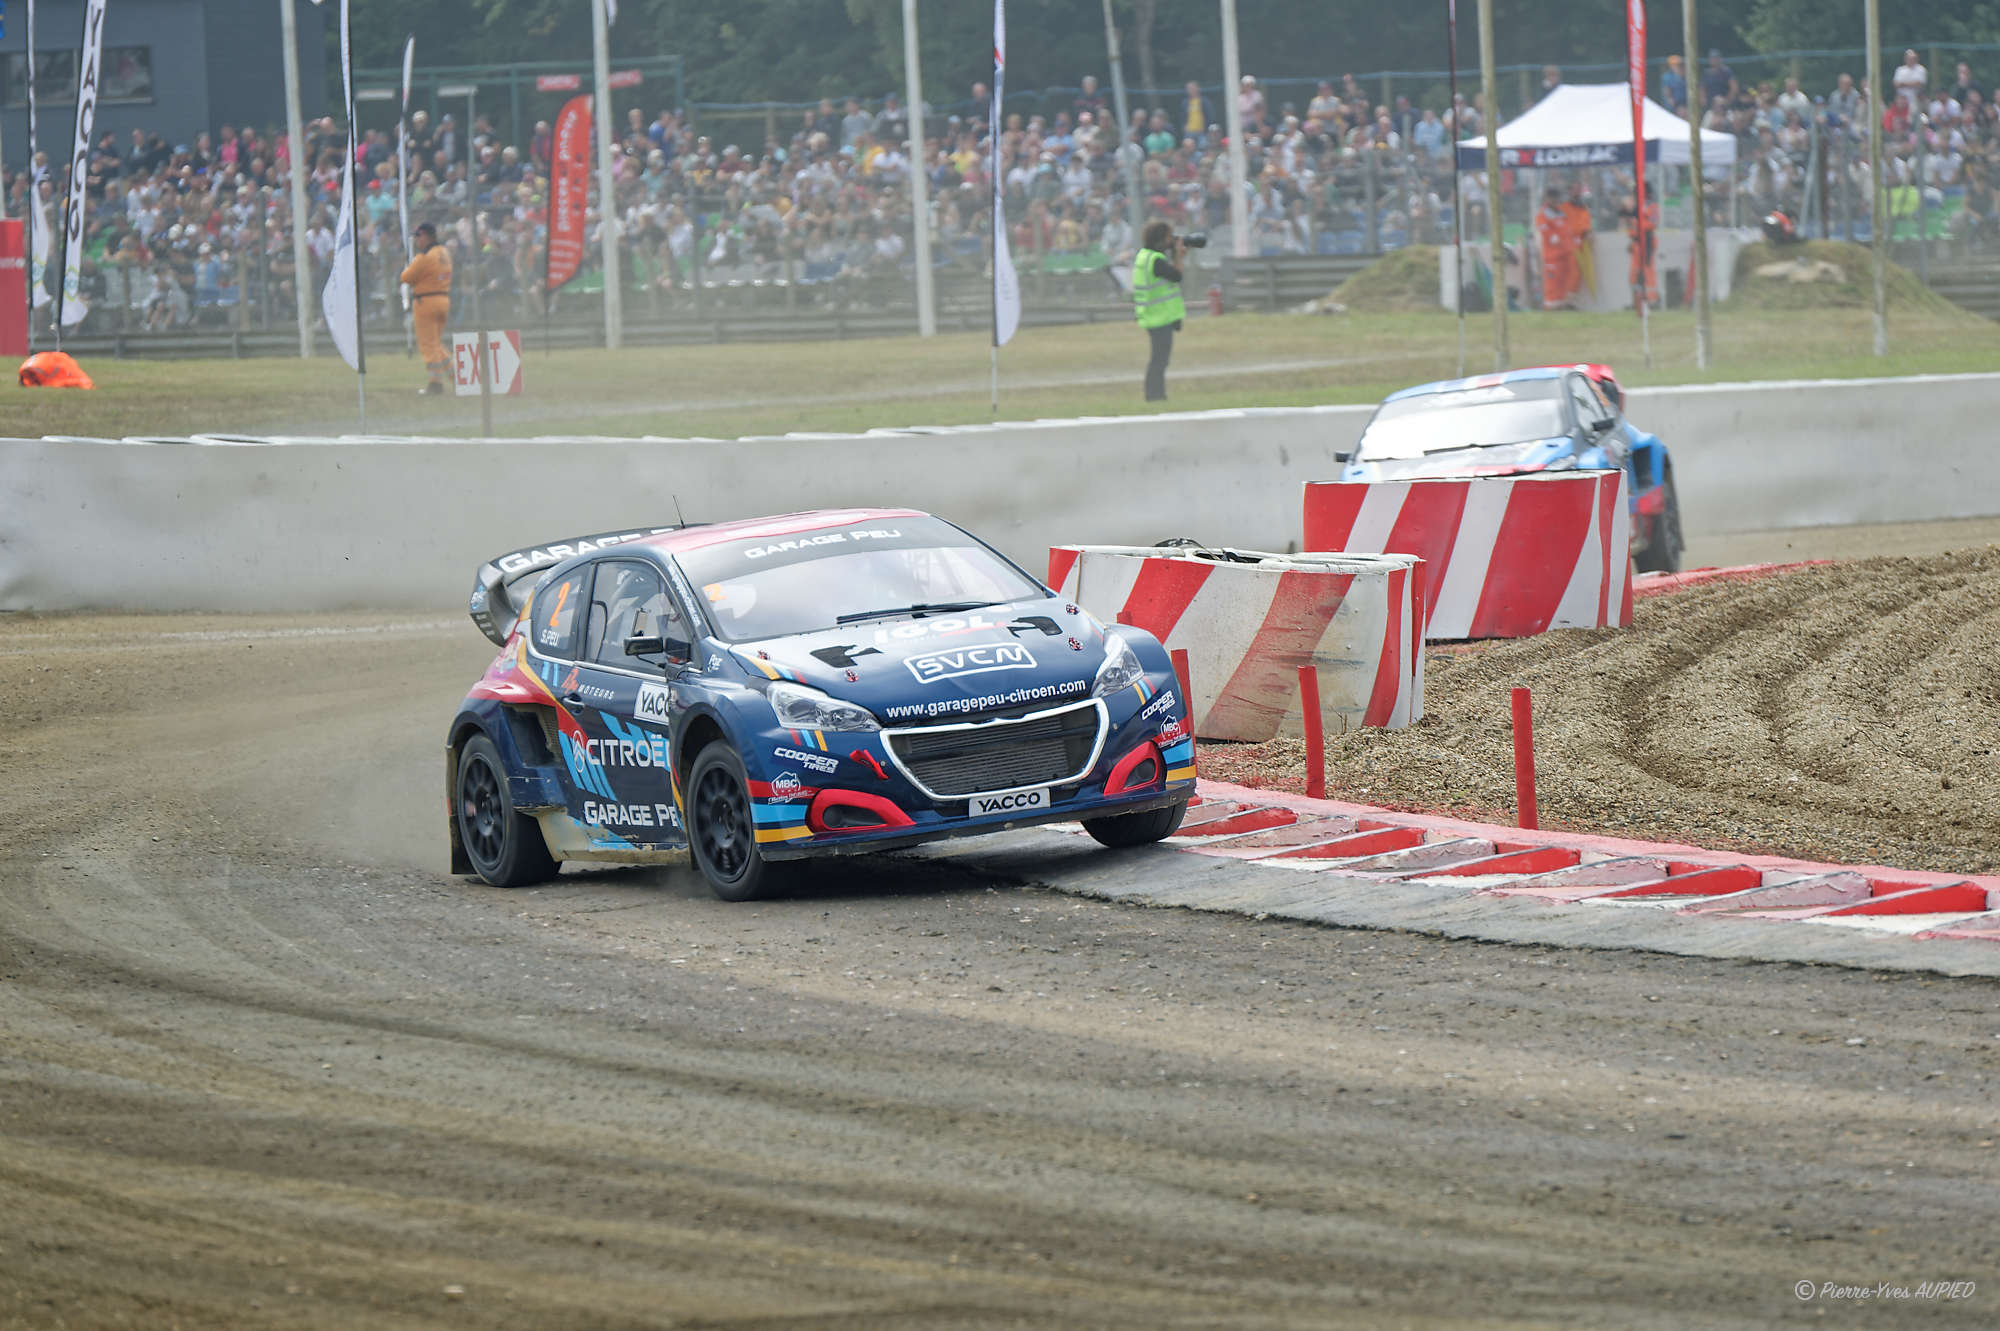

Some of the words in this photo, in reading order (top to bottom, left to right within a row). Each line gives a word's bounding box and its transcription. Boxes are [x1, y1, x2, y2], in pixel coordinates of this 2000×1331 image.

[70, 4, 102, 242] YACCO
[456, 342, 500, 384] EXT
[744, 533, 847, 559] GARAGE
[850, 529, 902, 541] PEU
[549, 582, 570, 627] 2
[703, 584, 728, 602] 2
[874, 615, 995, 645] IGOL
[916, 647, 1023, 676] SVCN
[578, 684, 615, 700] MOTEURS
[886, 678, 1087, 718] www.garagepeu-citroen.com
[1142, 690, 1175, 720] COOPER
[1163, 722, 1179, 733] MBC
[774, 747, 839, 768] COOPER
[803, 761, 836, 774] TIRES
[775, 779, 798, 789] MBC
[583, 801, 654, 826] GARAGE
[978, 792, 1041, 813] YACCO
